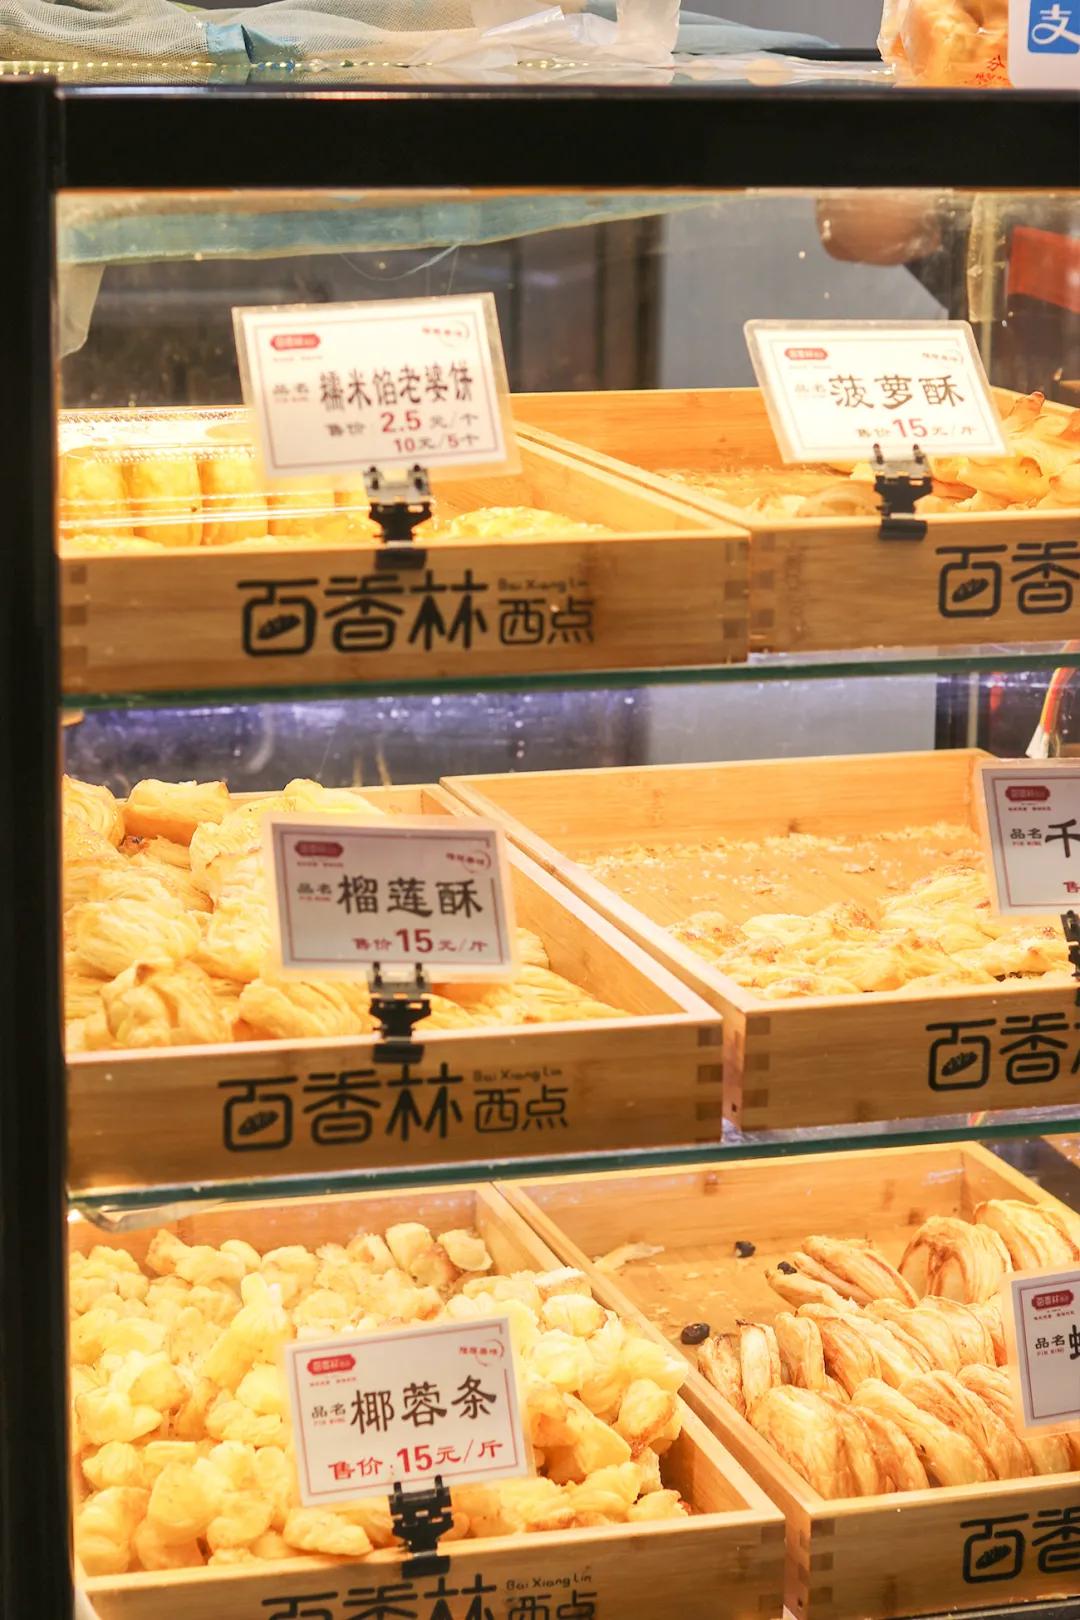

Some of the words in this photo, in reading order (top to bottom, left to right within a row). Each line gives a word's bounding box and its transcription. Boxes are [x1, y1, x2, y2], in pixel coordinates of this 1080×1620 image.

[828, 374, 965, 410] 菠萝酥
[337, 874, 483, 918] 榴莲酥
[925, 1012, 1080, 1092] 百香
[1035, 1334, 1065, 1349] 品名
[311, 1403, 346, 1419] 品名
[350, 1375, 497, 1435] 椰蓉条
